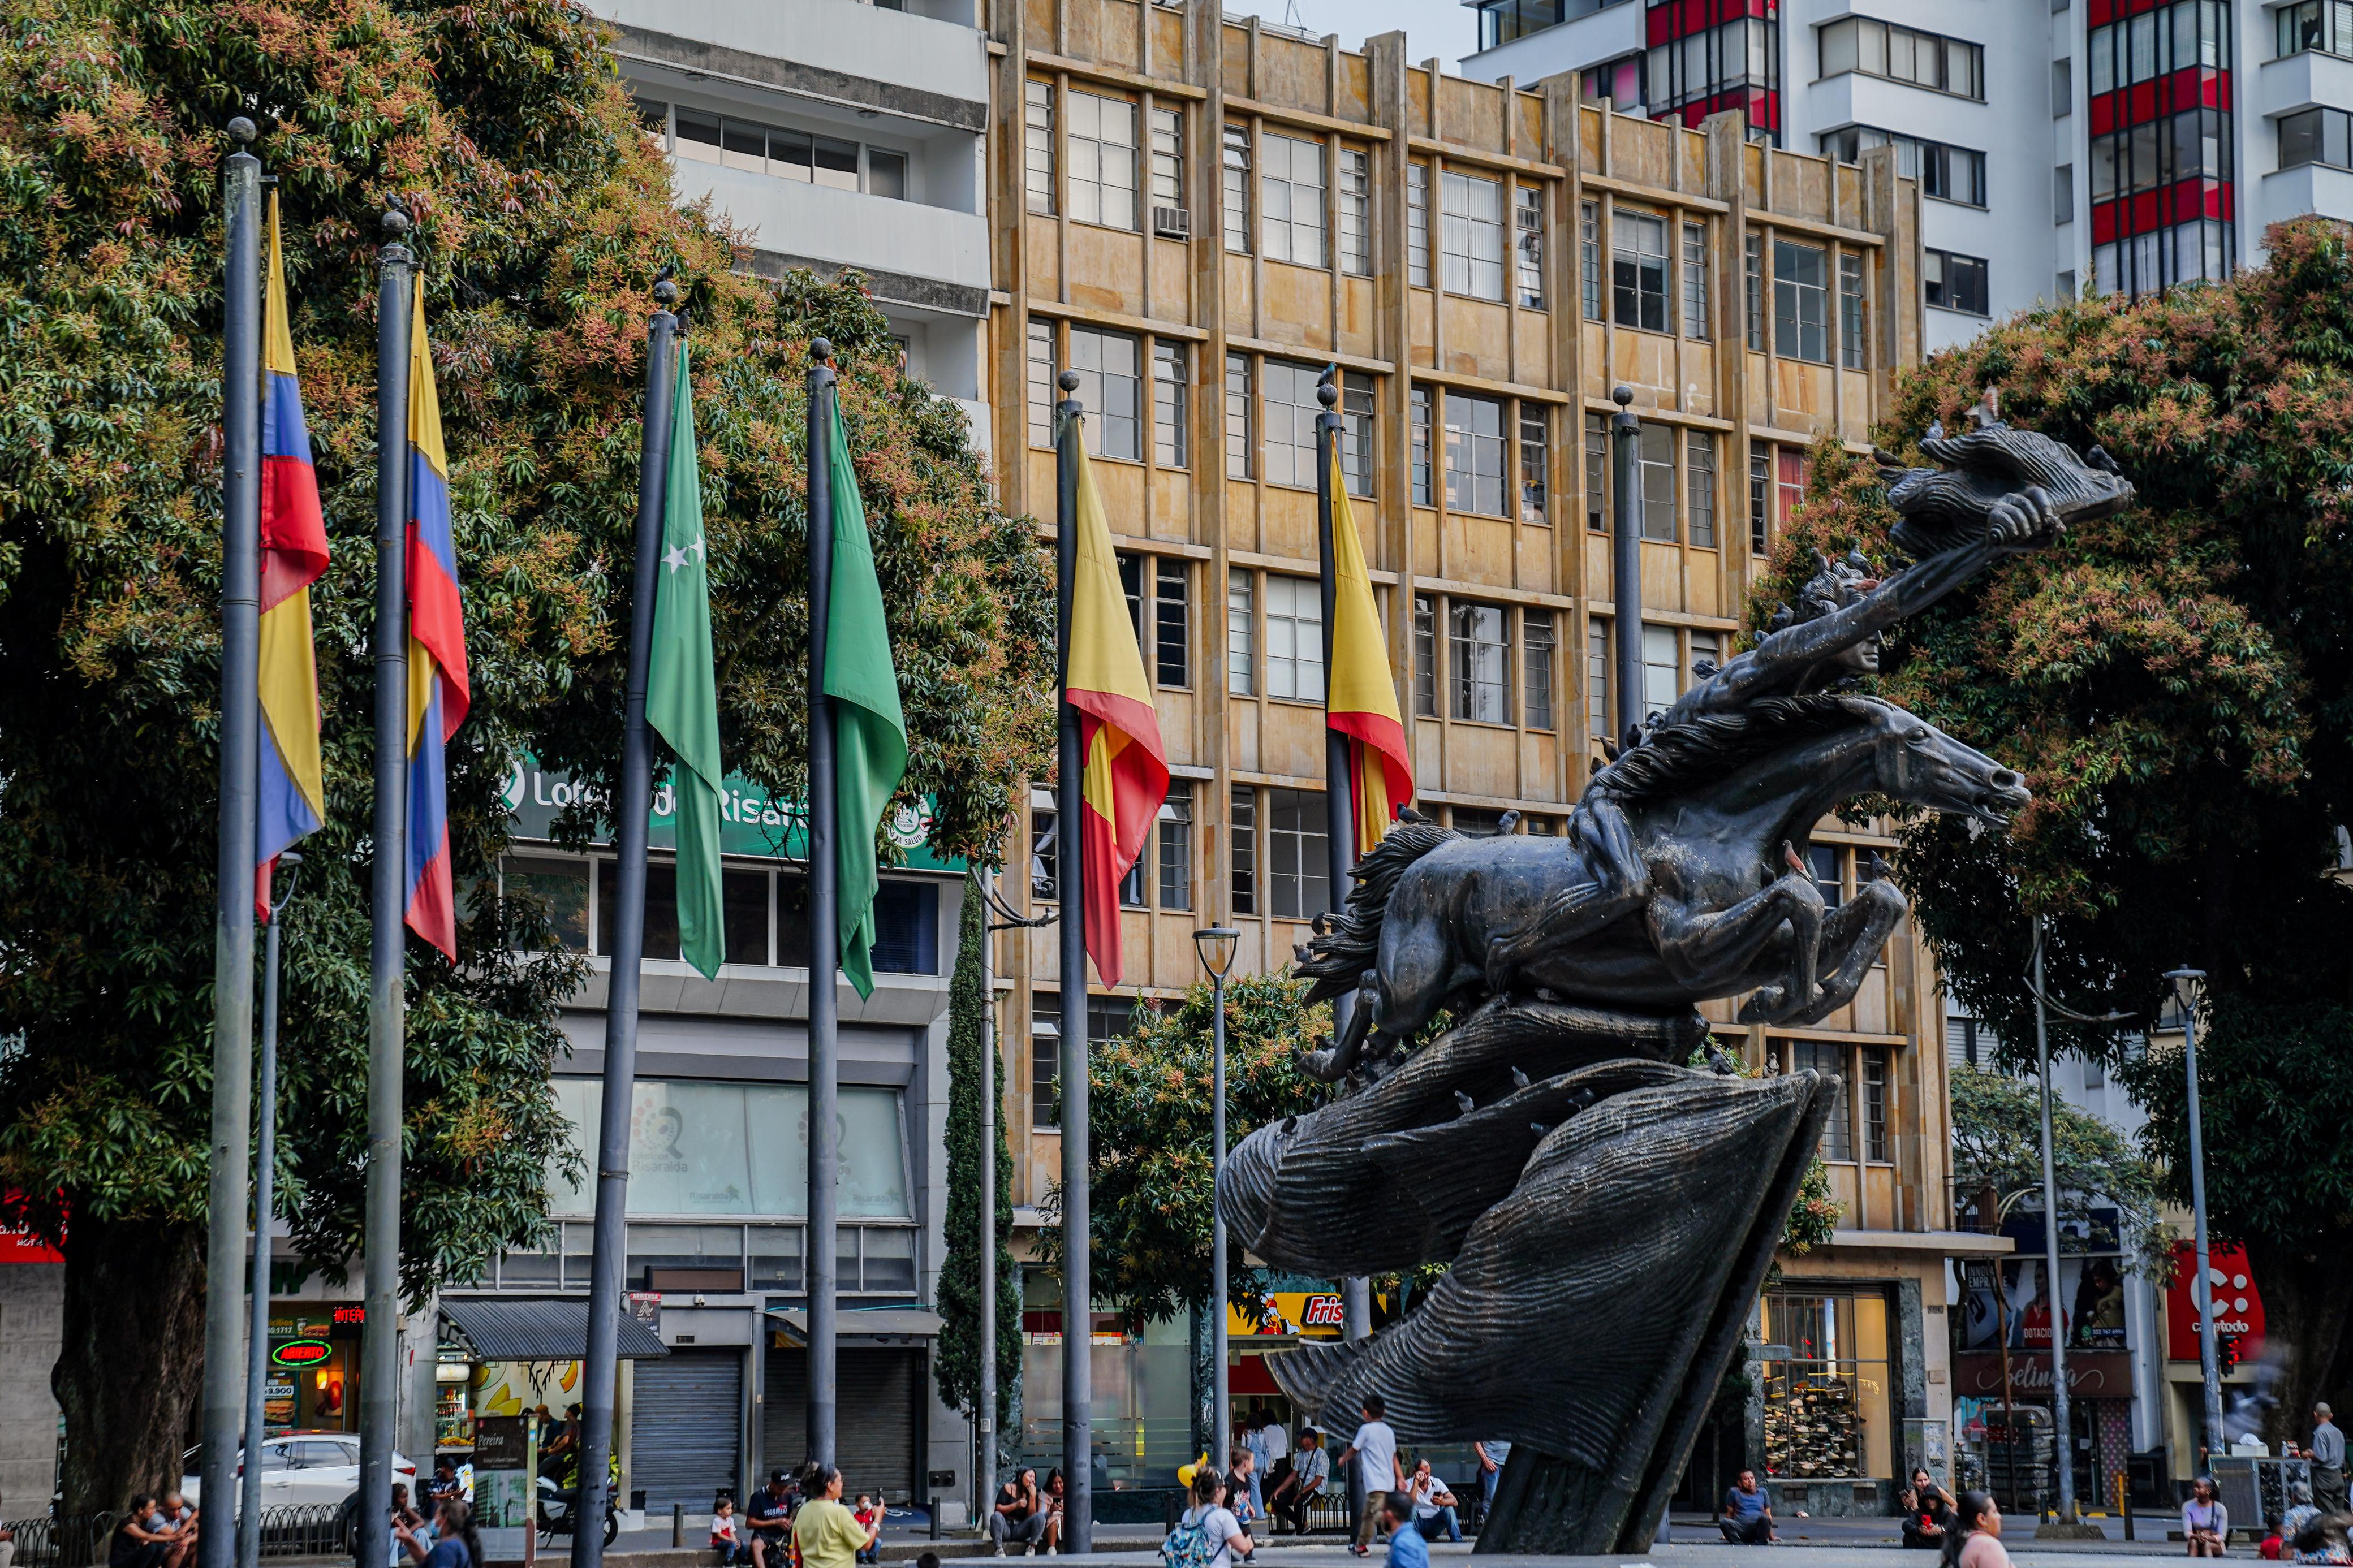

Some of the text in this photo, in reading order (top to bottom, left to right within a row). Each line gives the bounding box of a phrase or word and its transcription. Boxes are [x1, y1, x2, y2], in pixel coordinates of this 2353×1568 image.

[905, 834, 922, 846] SALUD
[632, 1160, 688, 1172] Risaralda
[689, 1191, 729, 1200] Risaralda
[853, 1194, 890, 1203] Risaralda
[1968, 1276, 2007, 1288] EMPRE
[1307, 1297, 1343, 1324] Fris
[2024, 1327, 2052, 1338] DOTACIO
[280, 1346, 325, 1359] ABIERTO
[477, 1432, 504, 1446] Pereira
